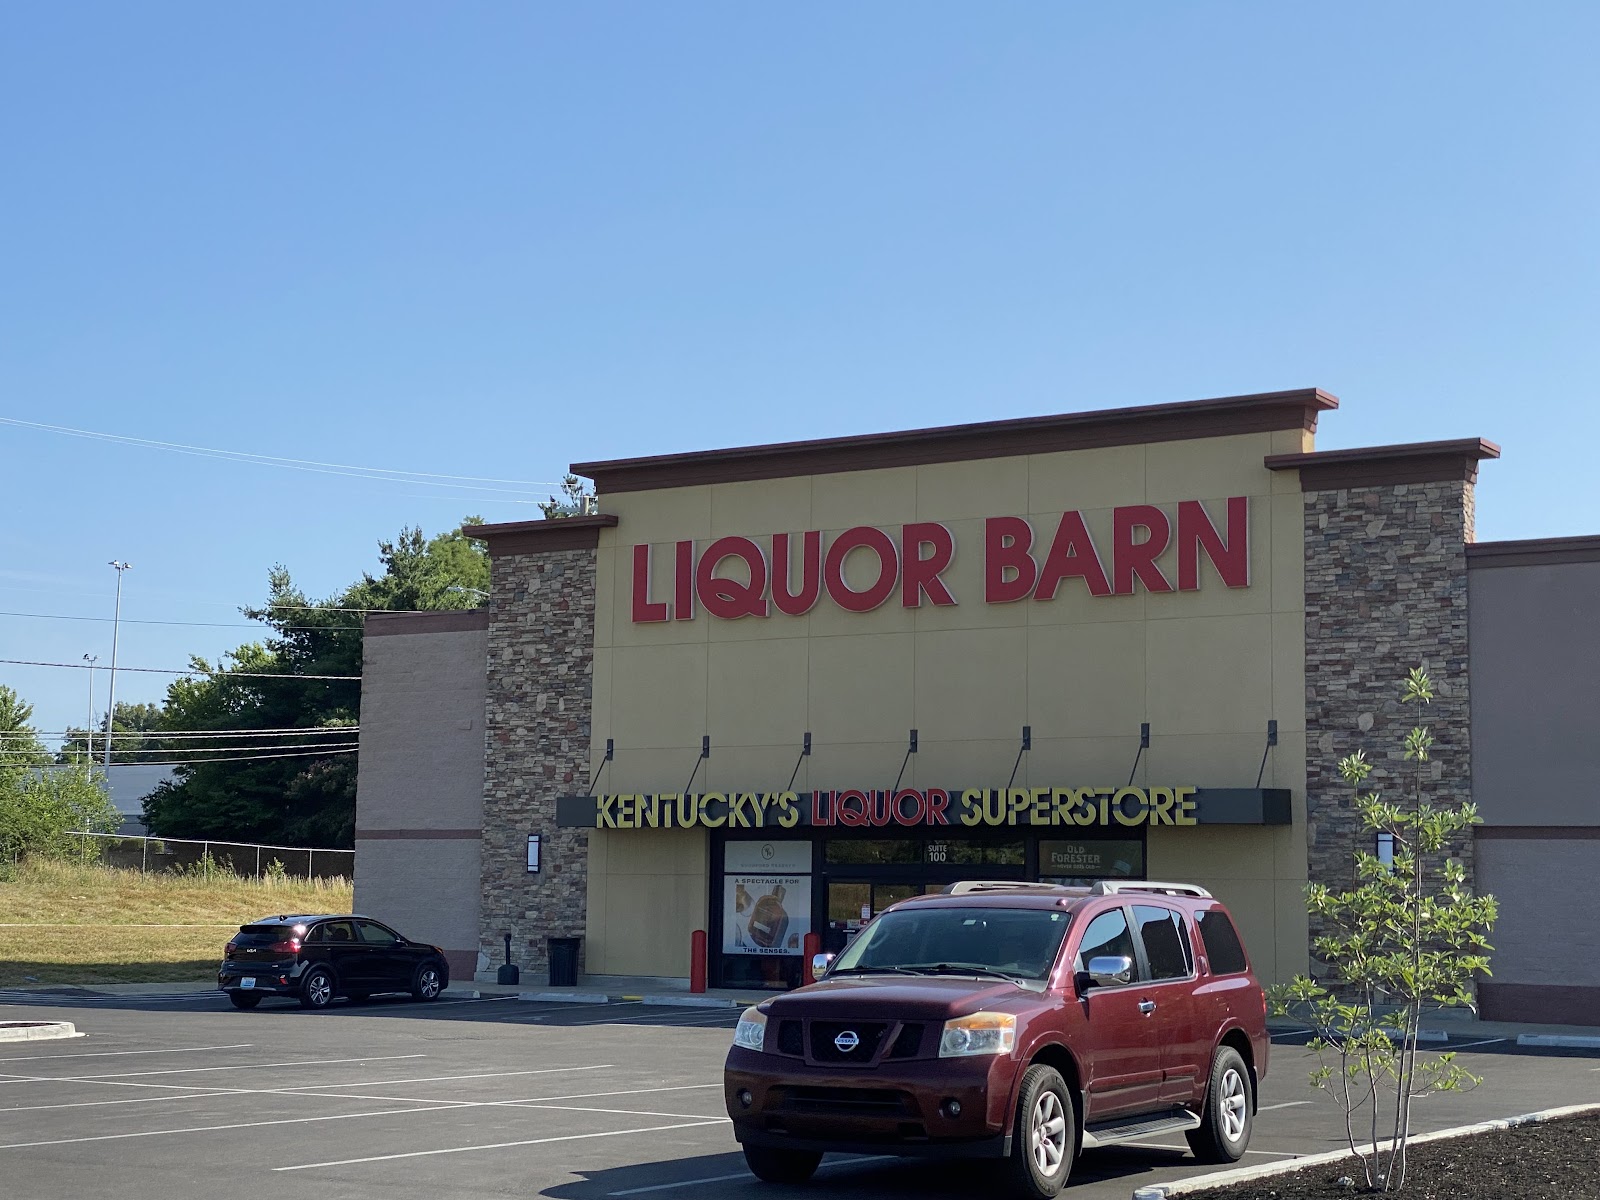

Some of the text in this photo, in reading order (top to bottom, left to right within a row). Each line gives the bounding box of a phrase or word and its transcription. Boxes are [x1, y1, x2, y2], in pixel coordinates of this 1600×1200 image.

[632, 496, 1250, 623] LIQUOR BARN
[597, 785, 1198, 829] KENTUCKY'S LIQUOR SUPERSTORE
[928, 844, 947, 852] SUITE
[1067, 844, 1085, 854] OLD
[929, 852, 946, 862] 100
[1051, 852, 1100, 863] FORESTER
